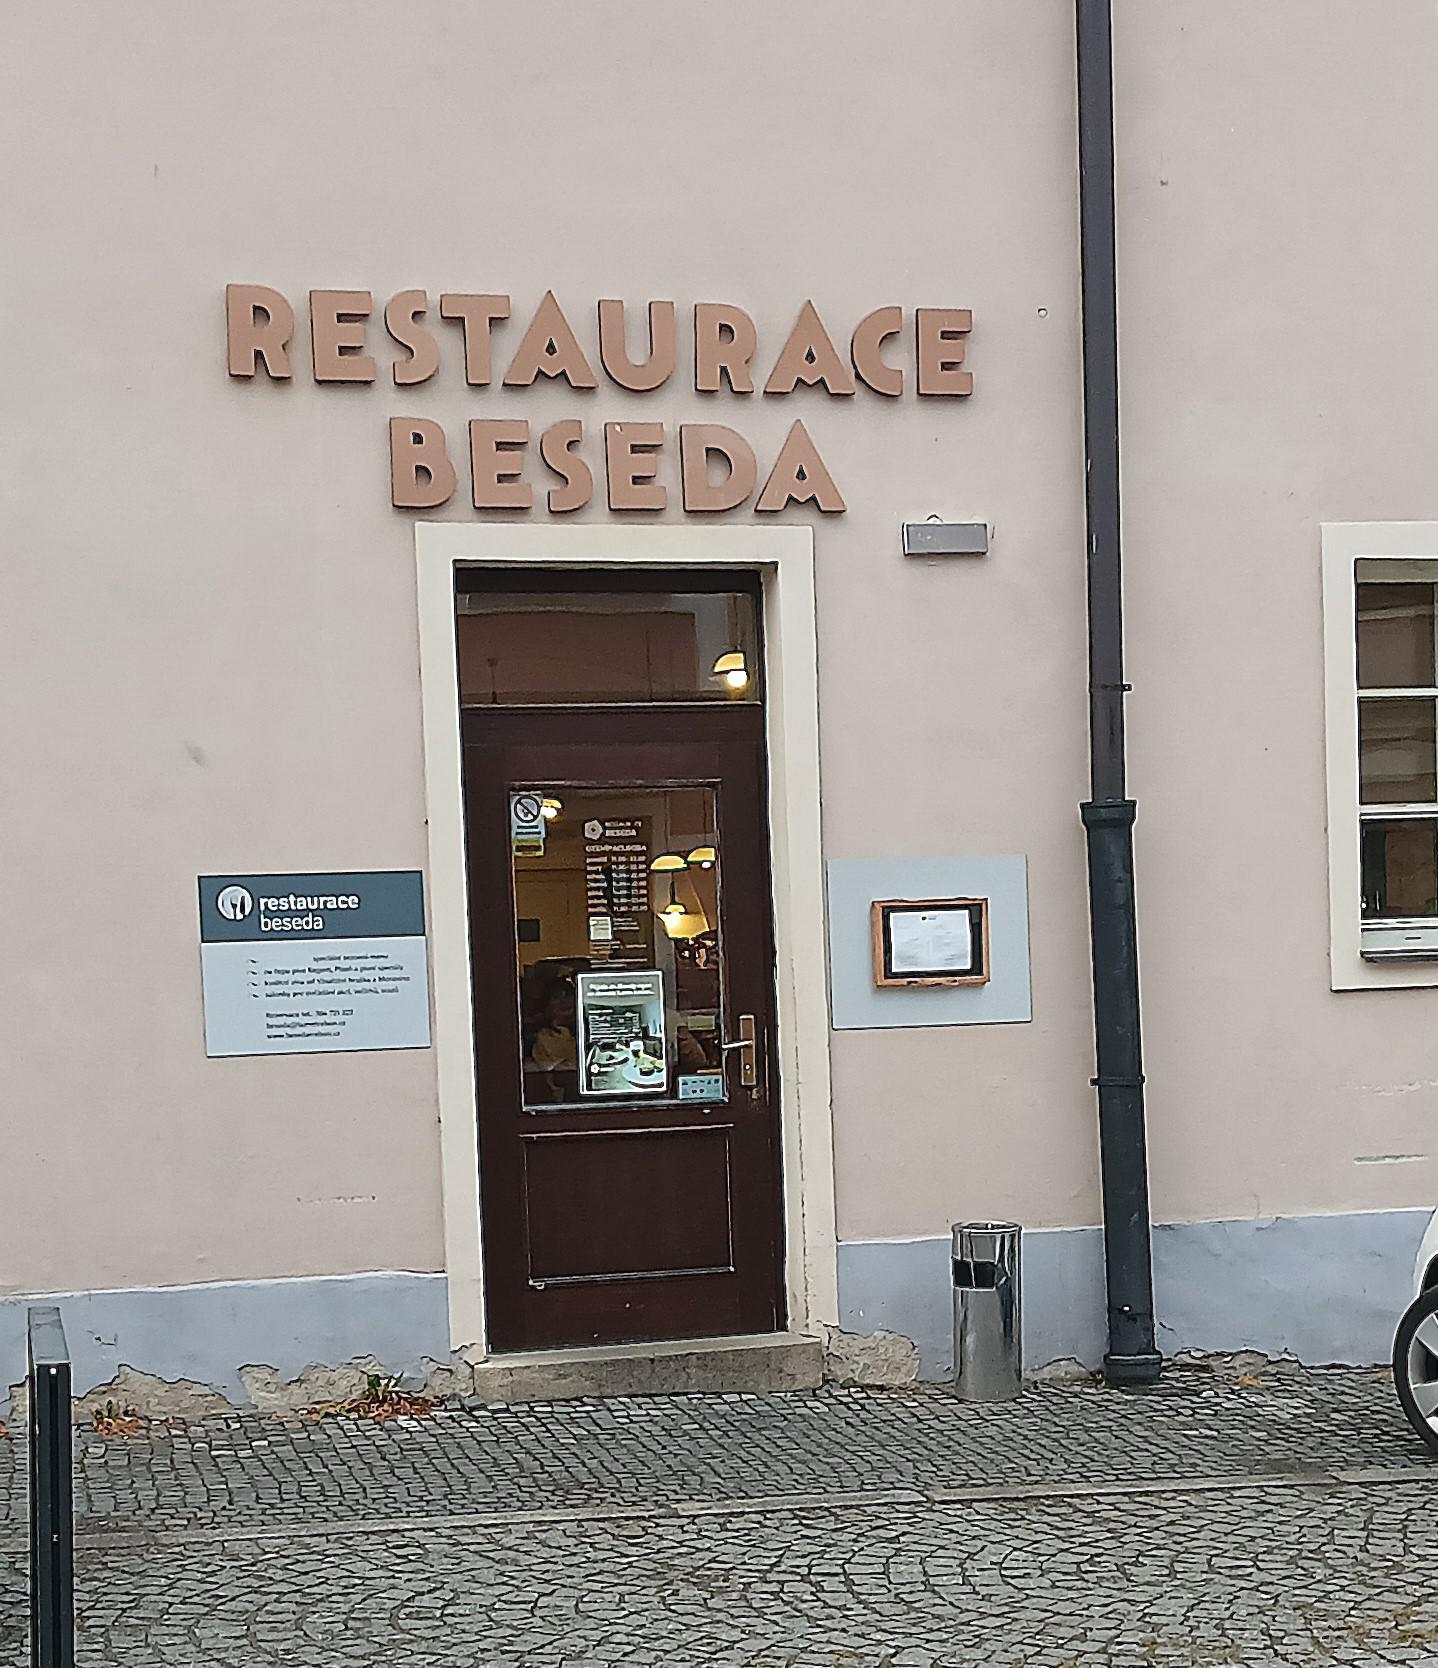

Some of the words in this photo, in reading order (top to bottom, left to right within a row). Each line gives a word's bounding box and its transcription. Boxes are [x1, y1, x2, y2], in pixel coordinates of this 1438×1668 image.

[226, 284, 975, 397] RESTAURACE
[389, 416, 846, 514] BESEDA
[259, 894, 359, 910] restaurace
[260, 912, 323, 931] beseda
